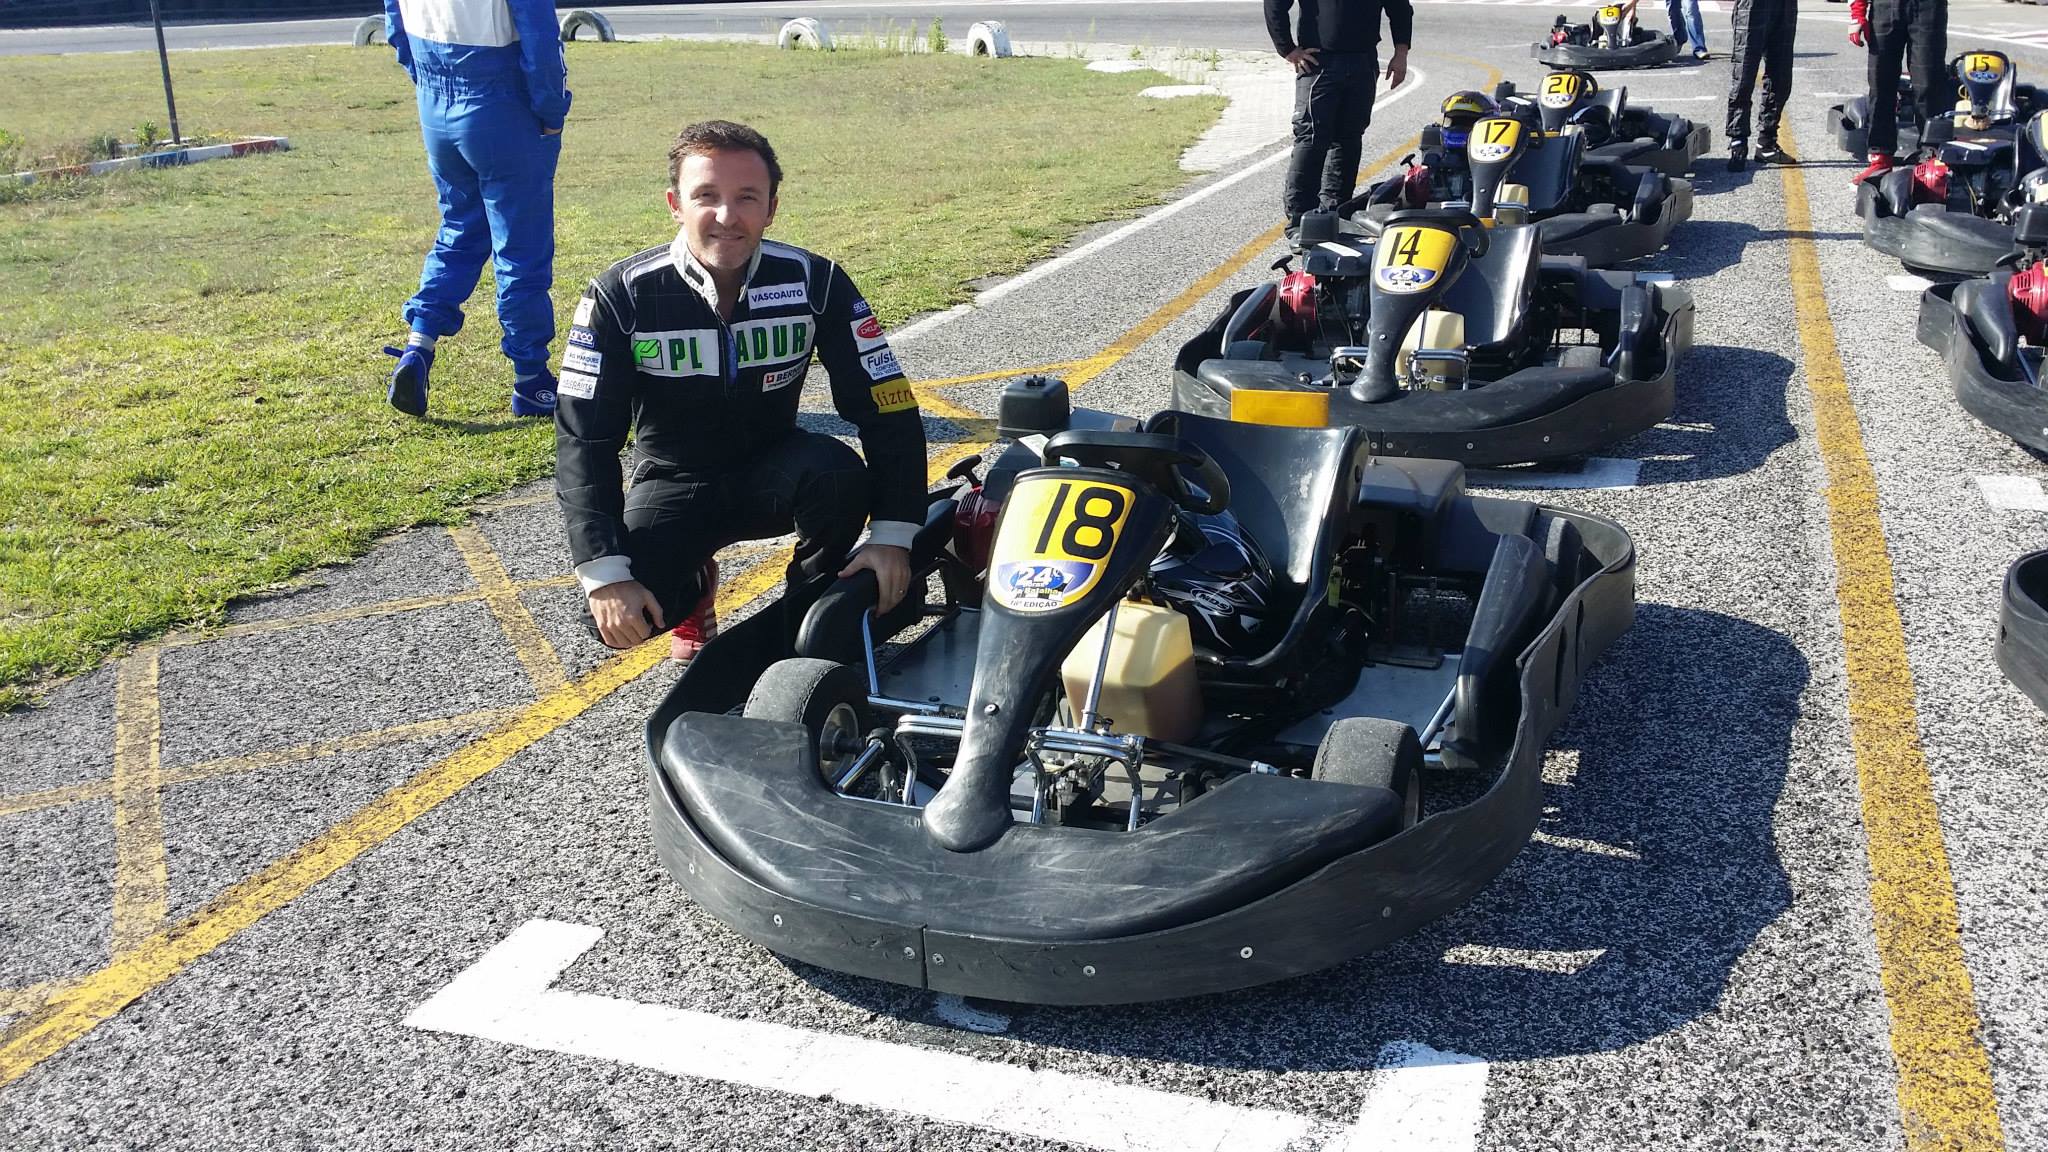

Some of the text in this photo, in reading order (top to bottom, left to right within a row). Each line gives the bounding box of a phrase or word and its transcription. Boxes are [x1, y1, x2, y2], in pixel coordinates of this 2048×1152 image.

[1607, 7, 1614, 17] 6
[1973, 56, 1990, 72] 15
[1548, 75, 1578, 95] 20
[1484, 122, 1512, 144] 17
[1387, 229, 1422, 267] 14
[751, 289, 803, 302] VASCOAUTO
[867, 350, 896, 369] Fulst
[1034, 483, 1125, 560] 18
[1016, 566, 1056, 587] 24
[1023, 601, 1058, 609] EDIÇÃO
